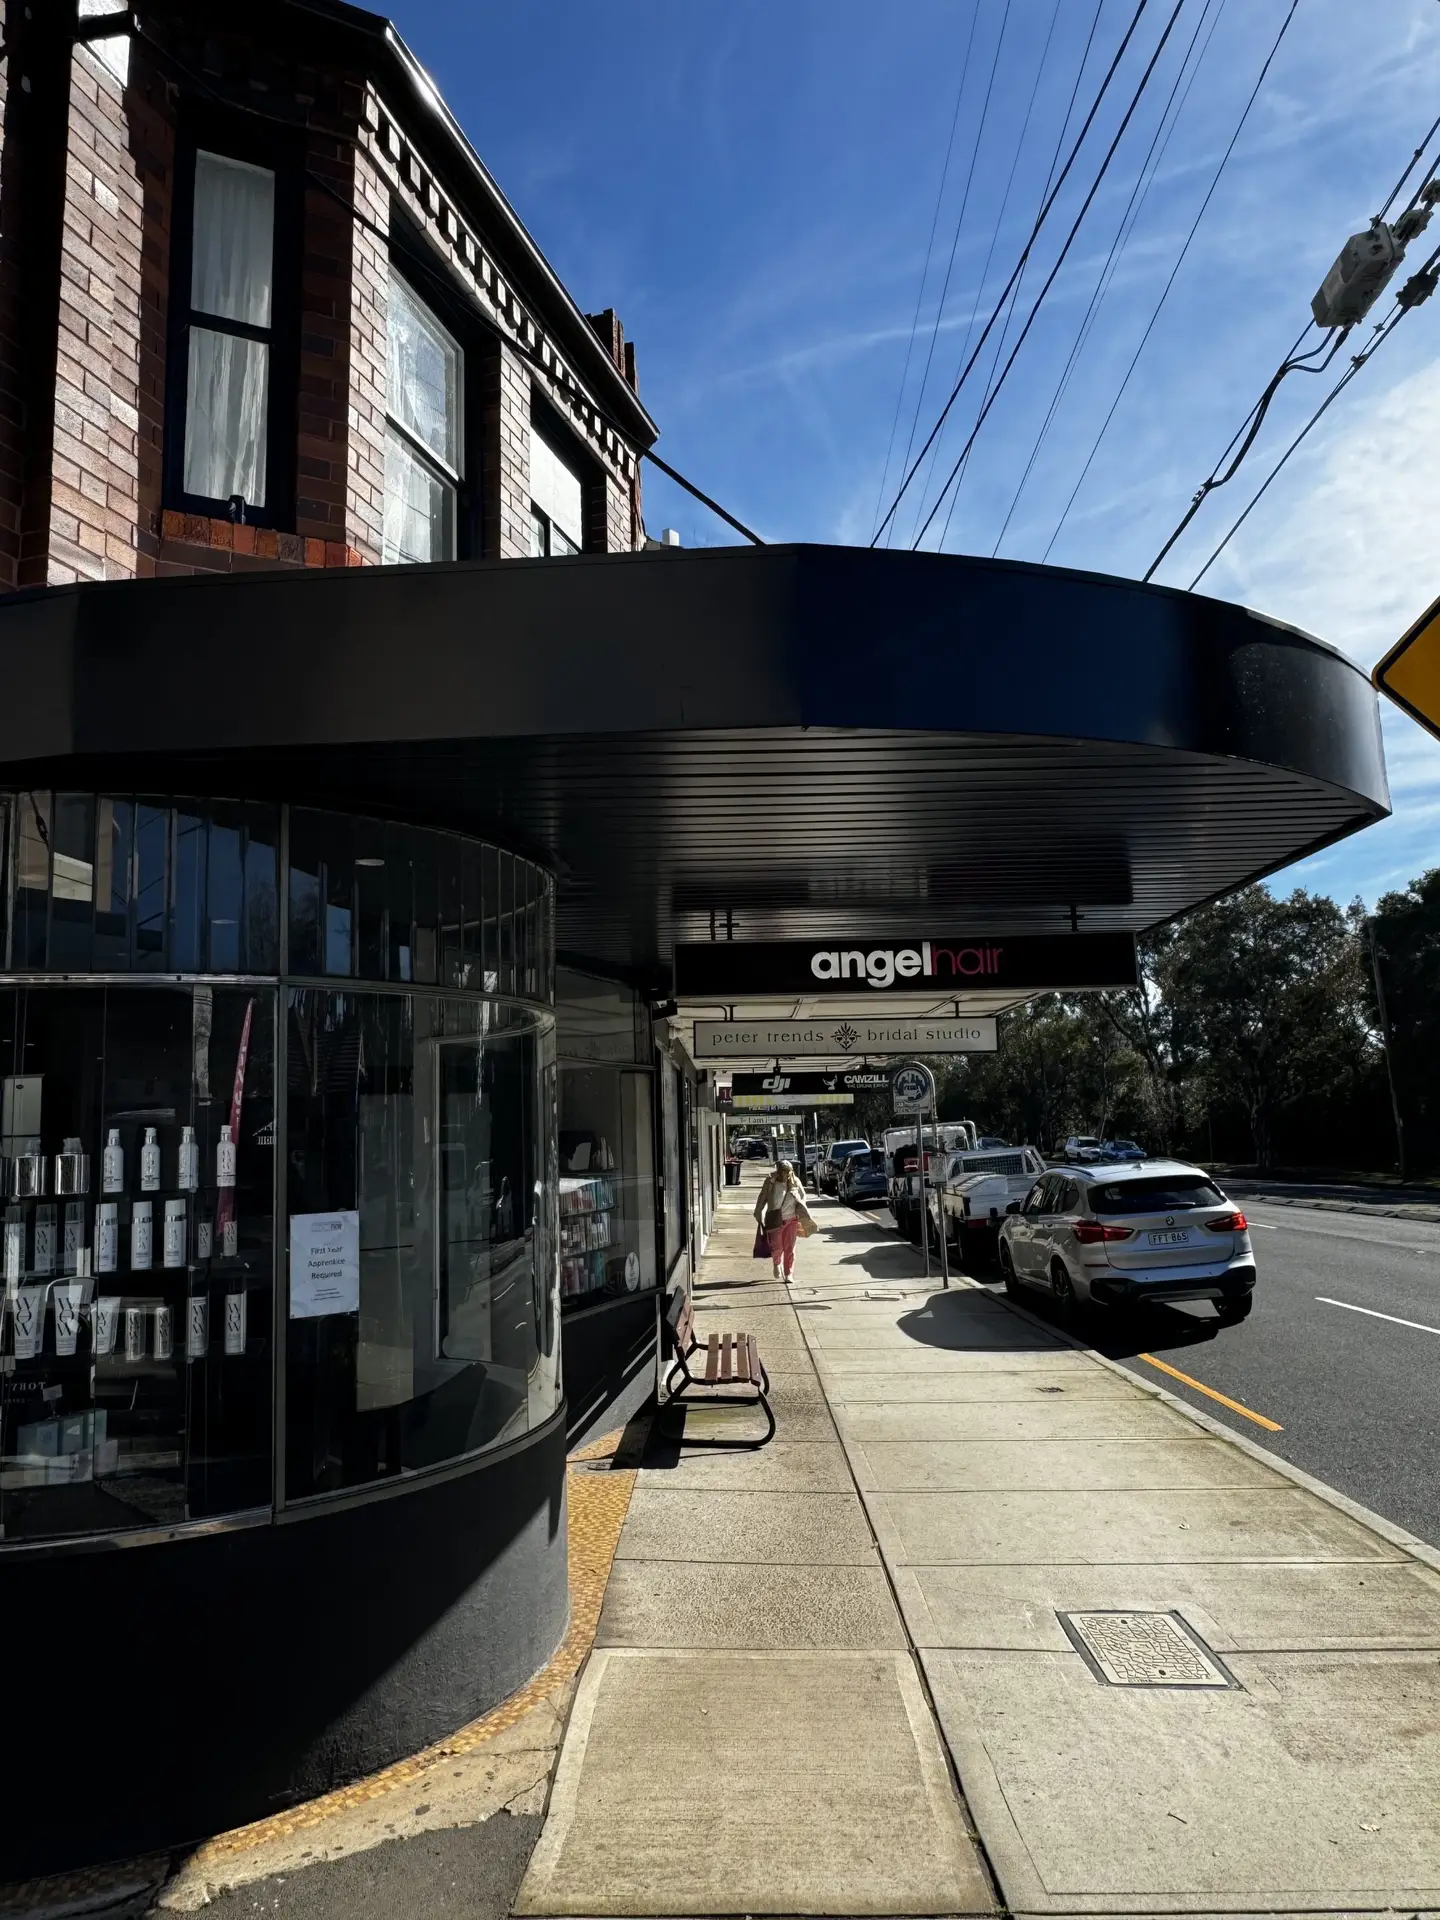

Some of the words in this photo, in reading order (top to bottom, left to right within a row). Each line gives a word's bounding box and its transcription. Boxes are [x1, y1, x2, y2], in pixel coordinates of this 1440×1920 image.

[767, 1029, 824, 1042] trends
[868, 1028, 918, 1041] bridal
[926, 1027, 981, 1040] studio
[310, 1247, 326, 1255] First
[308, 1258, 346, 1268] Apprentice
[311, 1270, 343, 1280] Required
